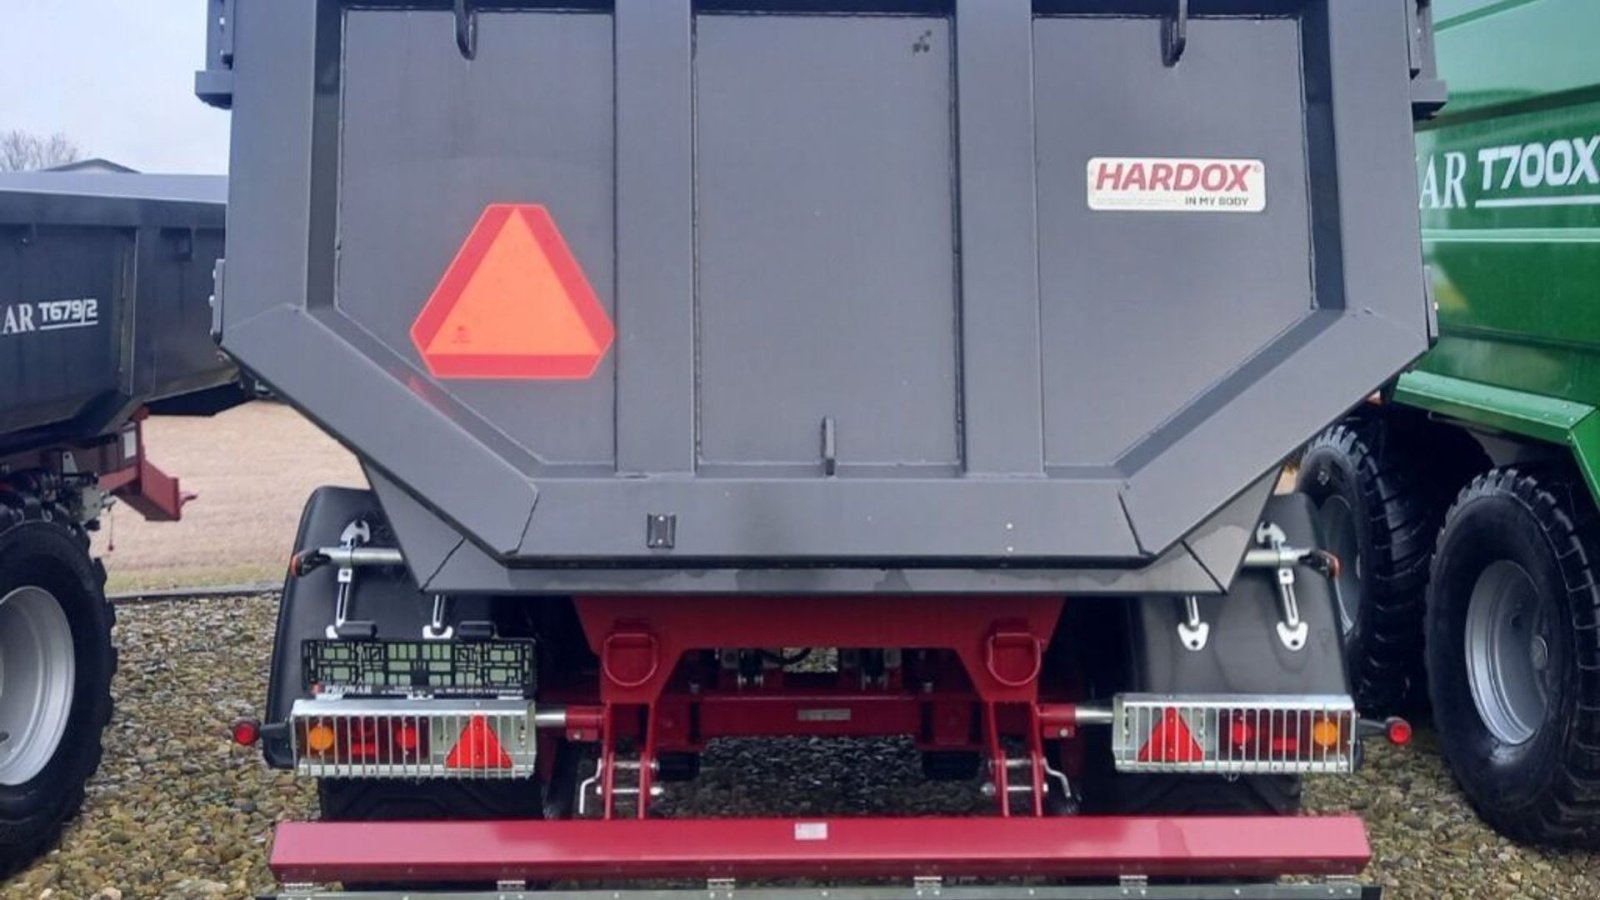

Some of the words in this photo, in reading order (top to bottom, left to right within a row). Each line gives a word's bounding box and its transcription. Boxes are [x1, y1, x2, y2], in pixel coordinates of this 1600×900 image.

[1096, 163, 1251, 192] HARDOX
[1416, 151, 1468, 209] AR
[1477, 135, 1600, 190] T700X
[1185, 196, 1197, 206] IN
[1199, 196, 1215, 206] MY
[1218, 196, 1249, 206] BODY
[0, 303, 36, 334] AR
